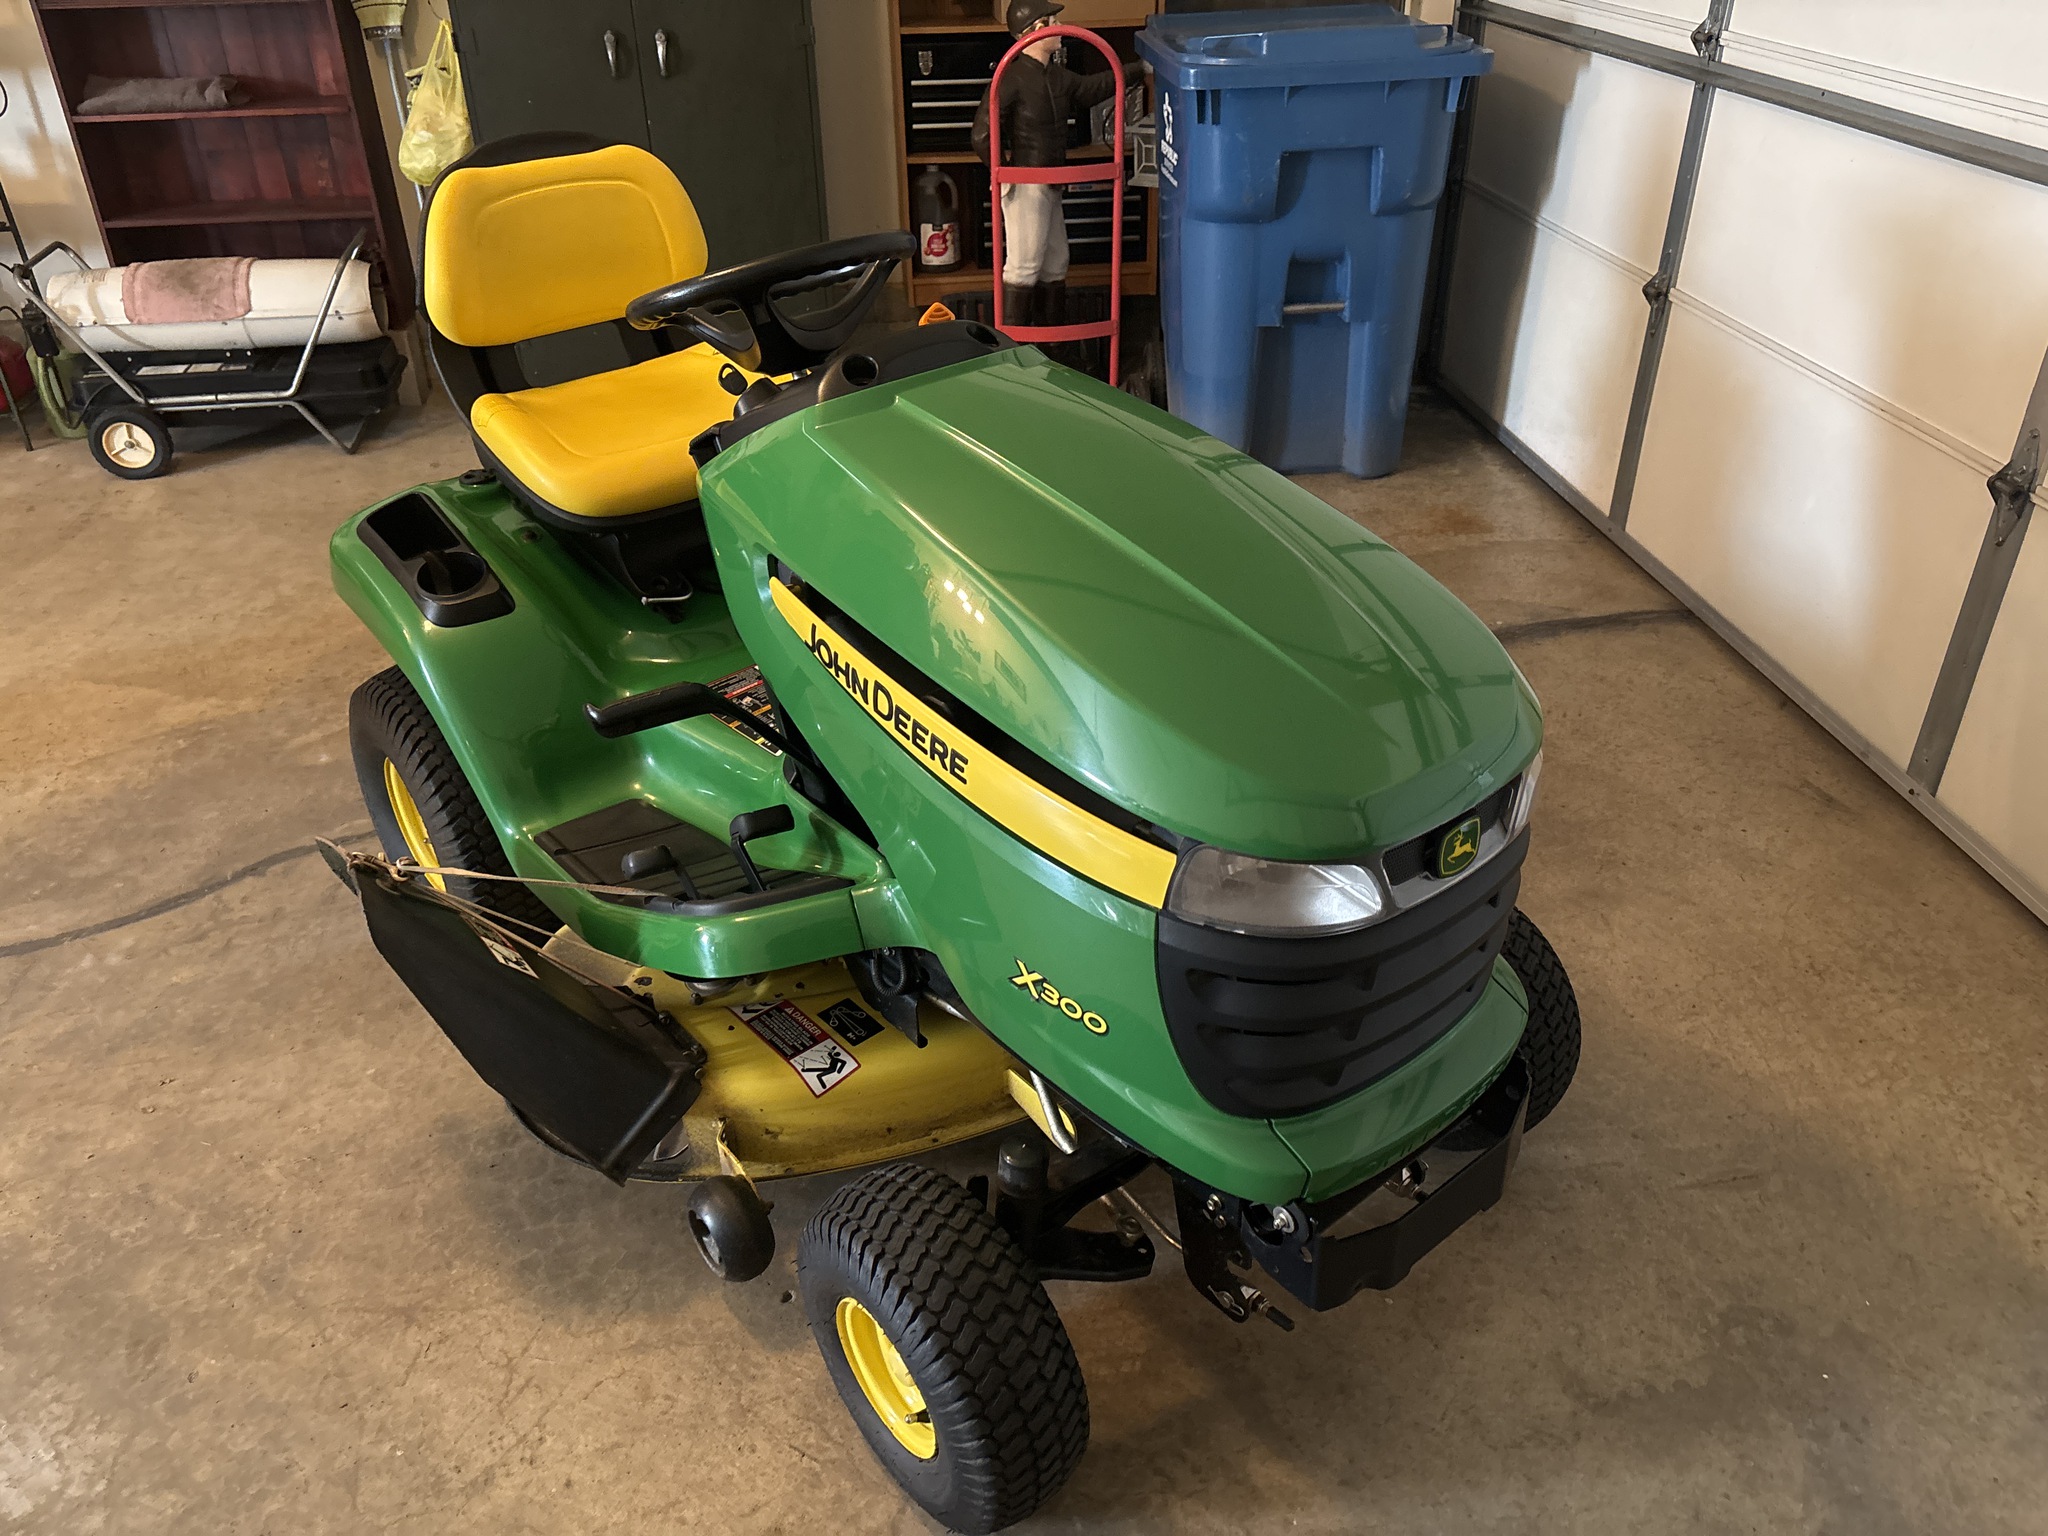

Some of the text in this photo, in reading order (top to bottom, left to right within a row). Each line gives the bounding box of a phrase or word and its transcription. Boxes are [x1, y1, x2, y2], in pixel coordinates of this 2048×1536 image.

[804, 623, 969, 785] JOHN DEERE
[791, 1010, 822, 1036] DANGER
[1007, 956, 1110, 1036] X300
